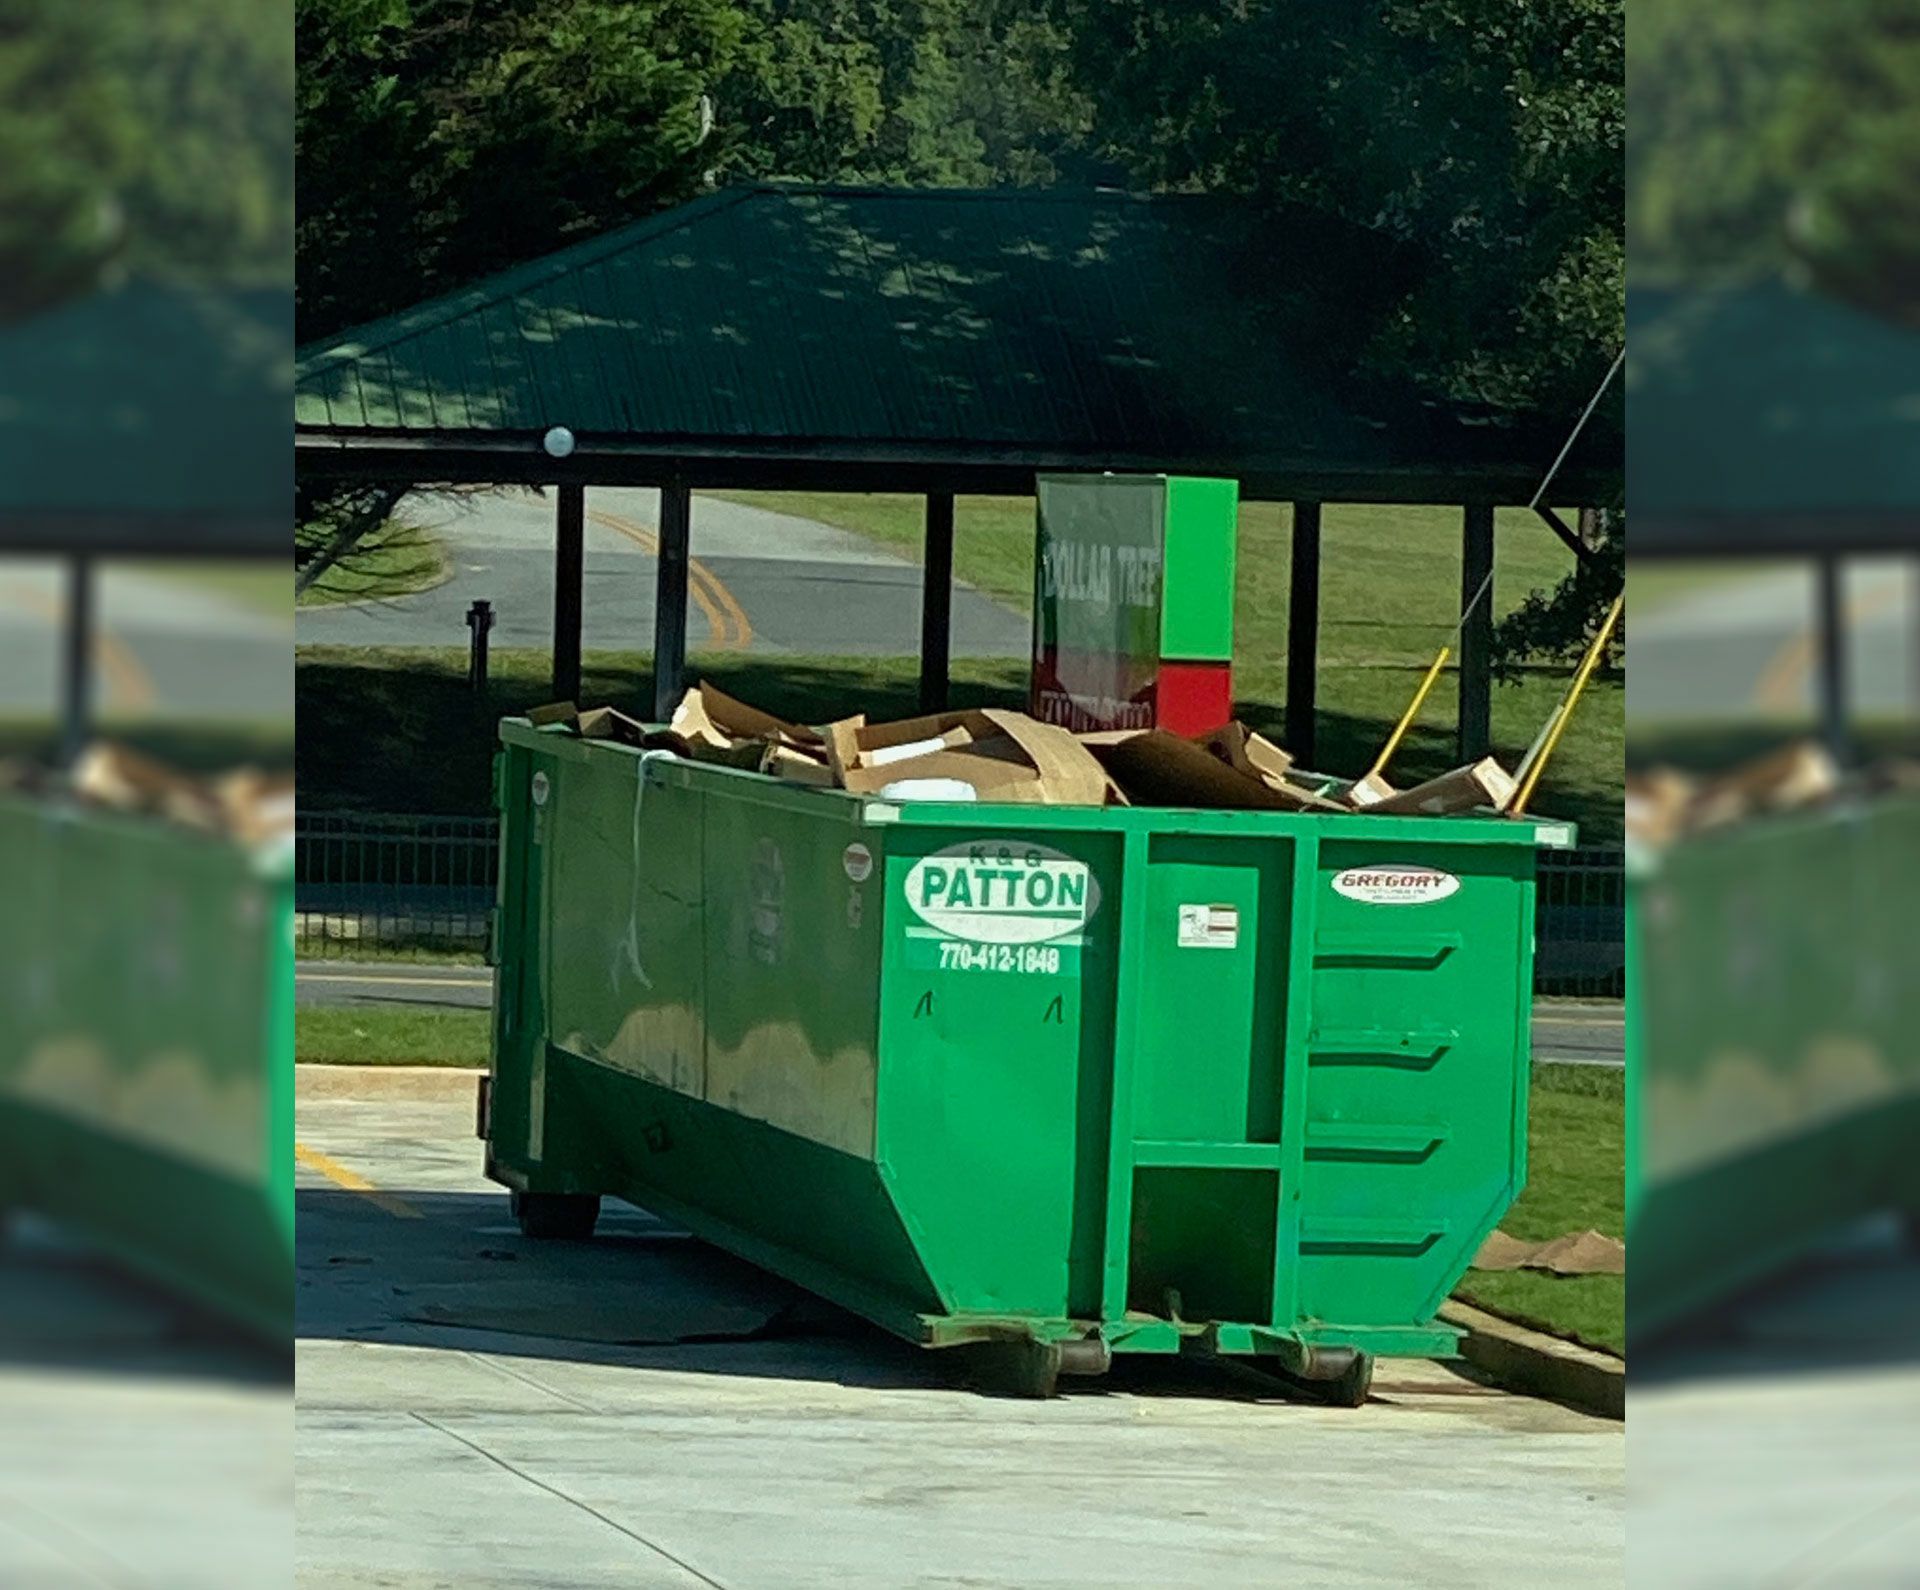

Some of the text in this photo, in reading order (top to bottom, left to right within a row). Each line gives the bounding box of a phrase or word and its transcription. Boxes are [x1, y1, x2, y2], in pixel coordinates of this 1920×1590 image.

[969, 845, 986, 866] K
[997, 848, 1013, 866] &
[921, 866, 1084, 908] PATTON
[1341, 873, 1447, 888] GREGORY
